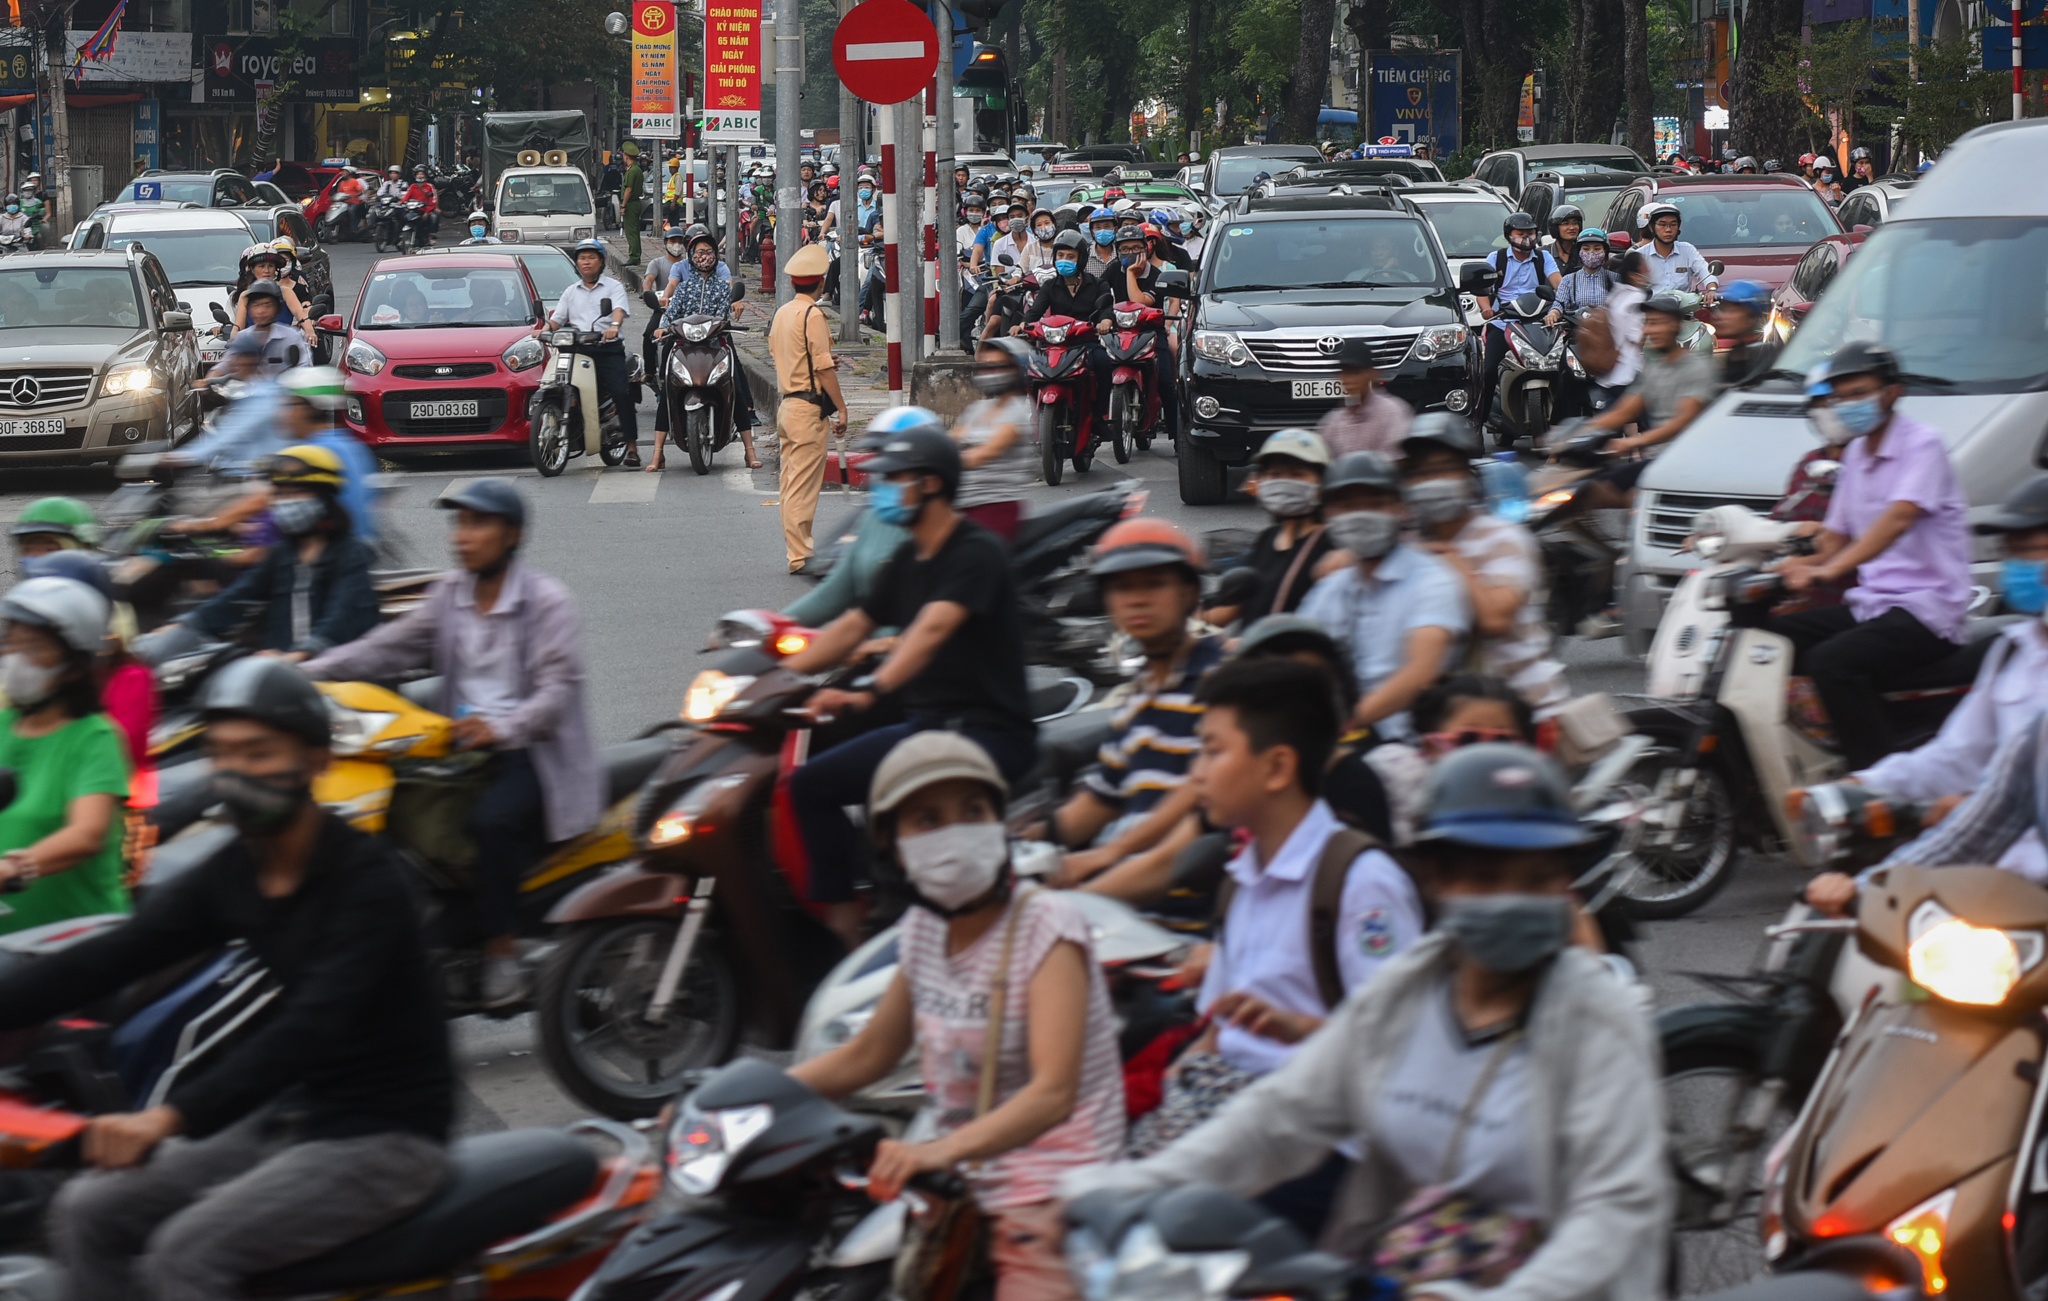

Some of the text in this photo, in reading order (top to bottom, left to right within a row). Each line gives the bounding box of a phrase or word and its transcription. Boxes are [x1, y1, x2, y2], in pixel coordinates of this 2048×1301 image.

[710, 7, 757, 18] CHÀO MỪNG
[716, 20, 750, 33] KỶ NIỆM
[718, 35, 749, 46] 65 NĂM
[722, 49, 744, 60] NGÀY
[710, 62, 756, 74] GIẢI PHÓNG
[1377, 67, 1407, 83] TIÊM
[719, 76, 747, 88] THỦ ĐÔ
[140, 105, 151, 120] LAN
[645, 118, 672, 127] ABIC
[723, 116, 758, 129] ABIC
[1417, 134, 1429, 143] 800
[139, 184, 154, 198] G7
[412, 403, 477, 417] 29D-083.68
